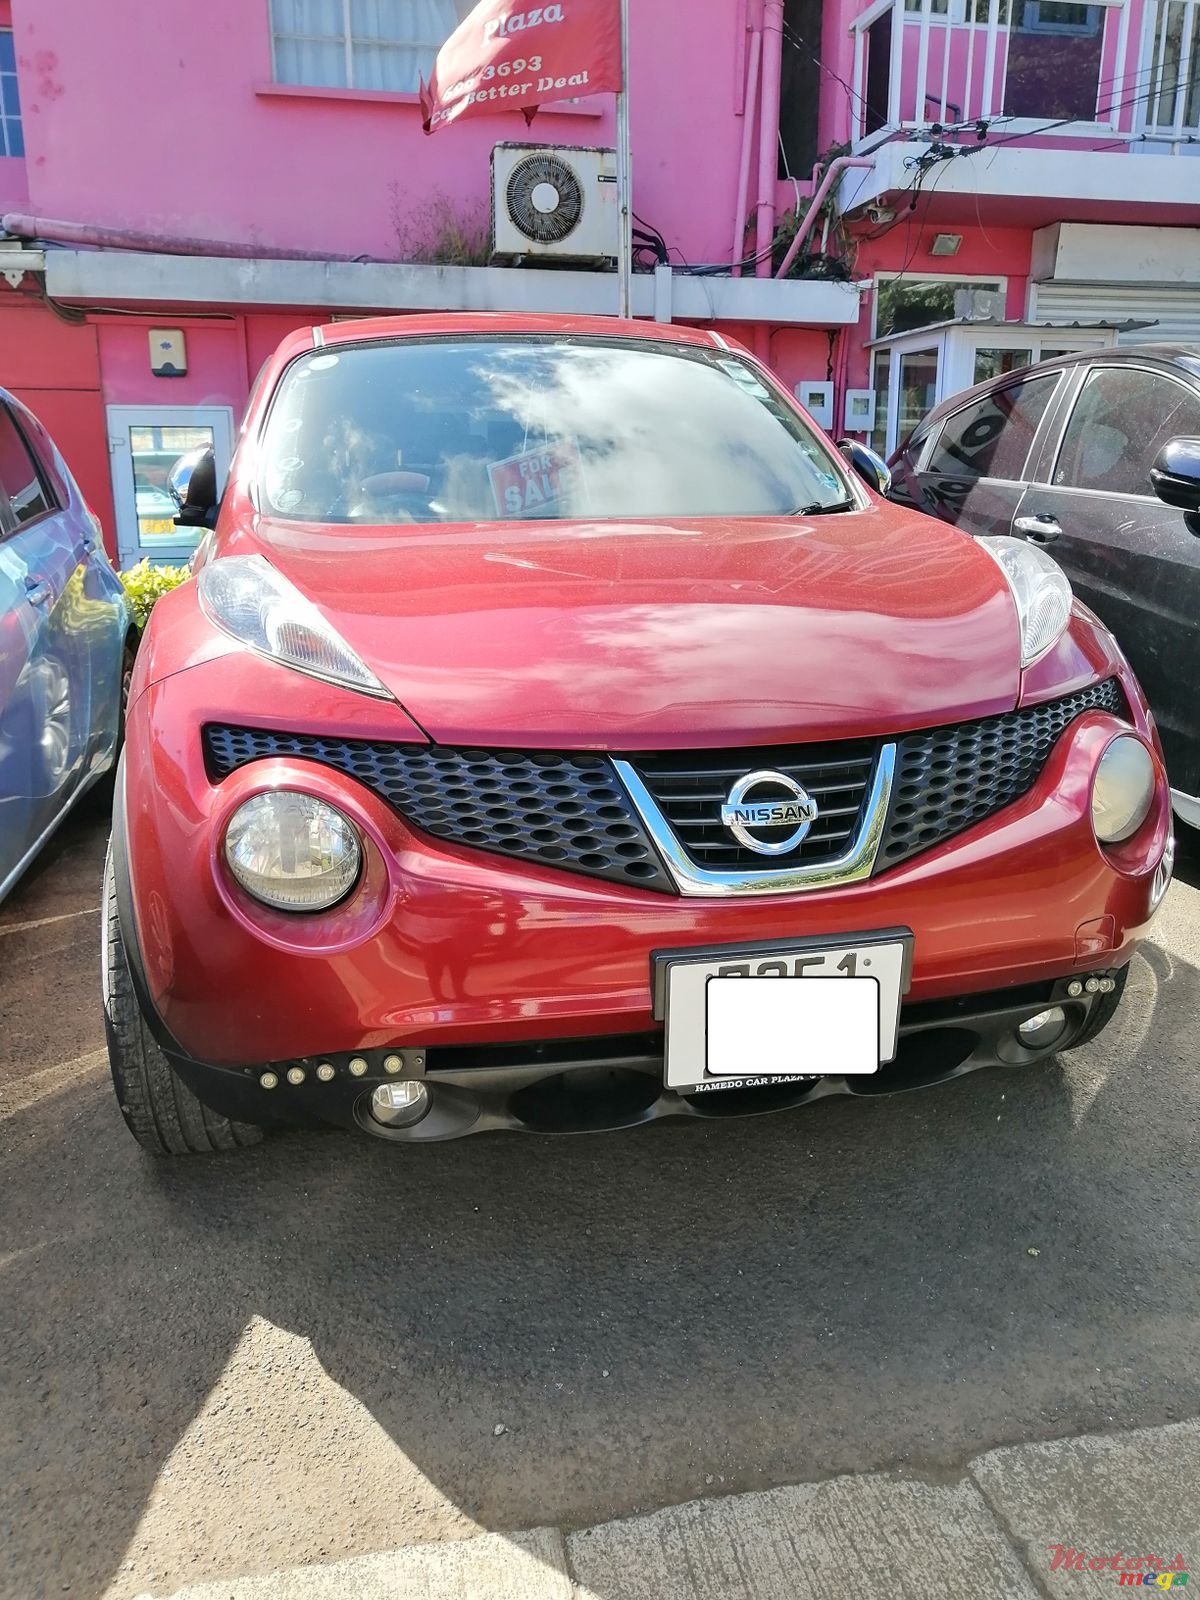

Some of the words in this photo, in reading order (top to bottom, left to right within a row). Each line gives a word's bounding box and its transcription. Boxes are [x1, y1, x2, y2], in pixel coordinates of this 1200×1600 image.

[481, 3, 564, 48] Plaza
[482, 56, 542, 81] 3693
[467, 82, 532, 105] Better
[537, 71, 589, 93] Deal
[519, 453, 552, 478] FOR
[734, 804, 811, 821] NISSAN
[695, 1080, 743, 1092] HAMEDO
[746, 1077, 768, 1087] CAR
[771, 1075, 804, 1084] PLAZA
